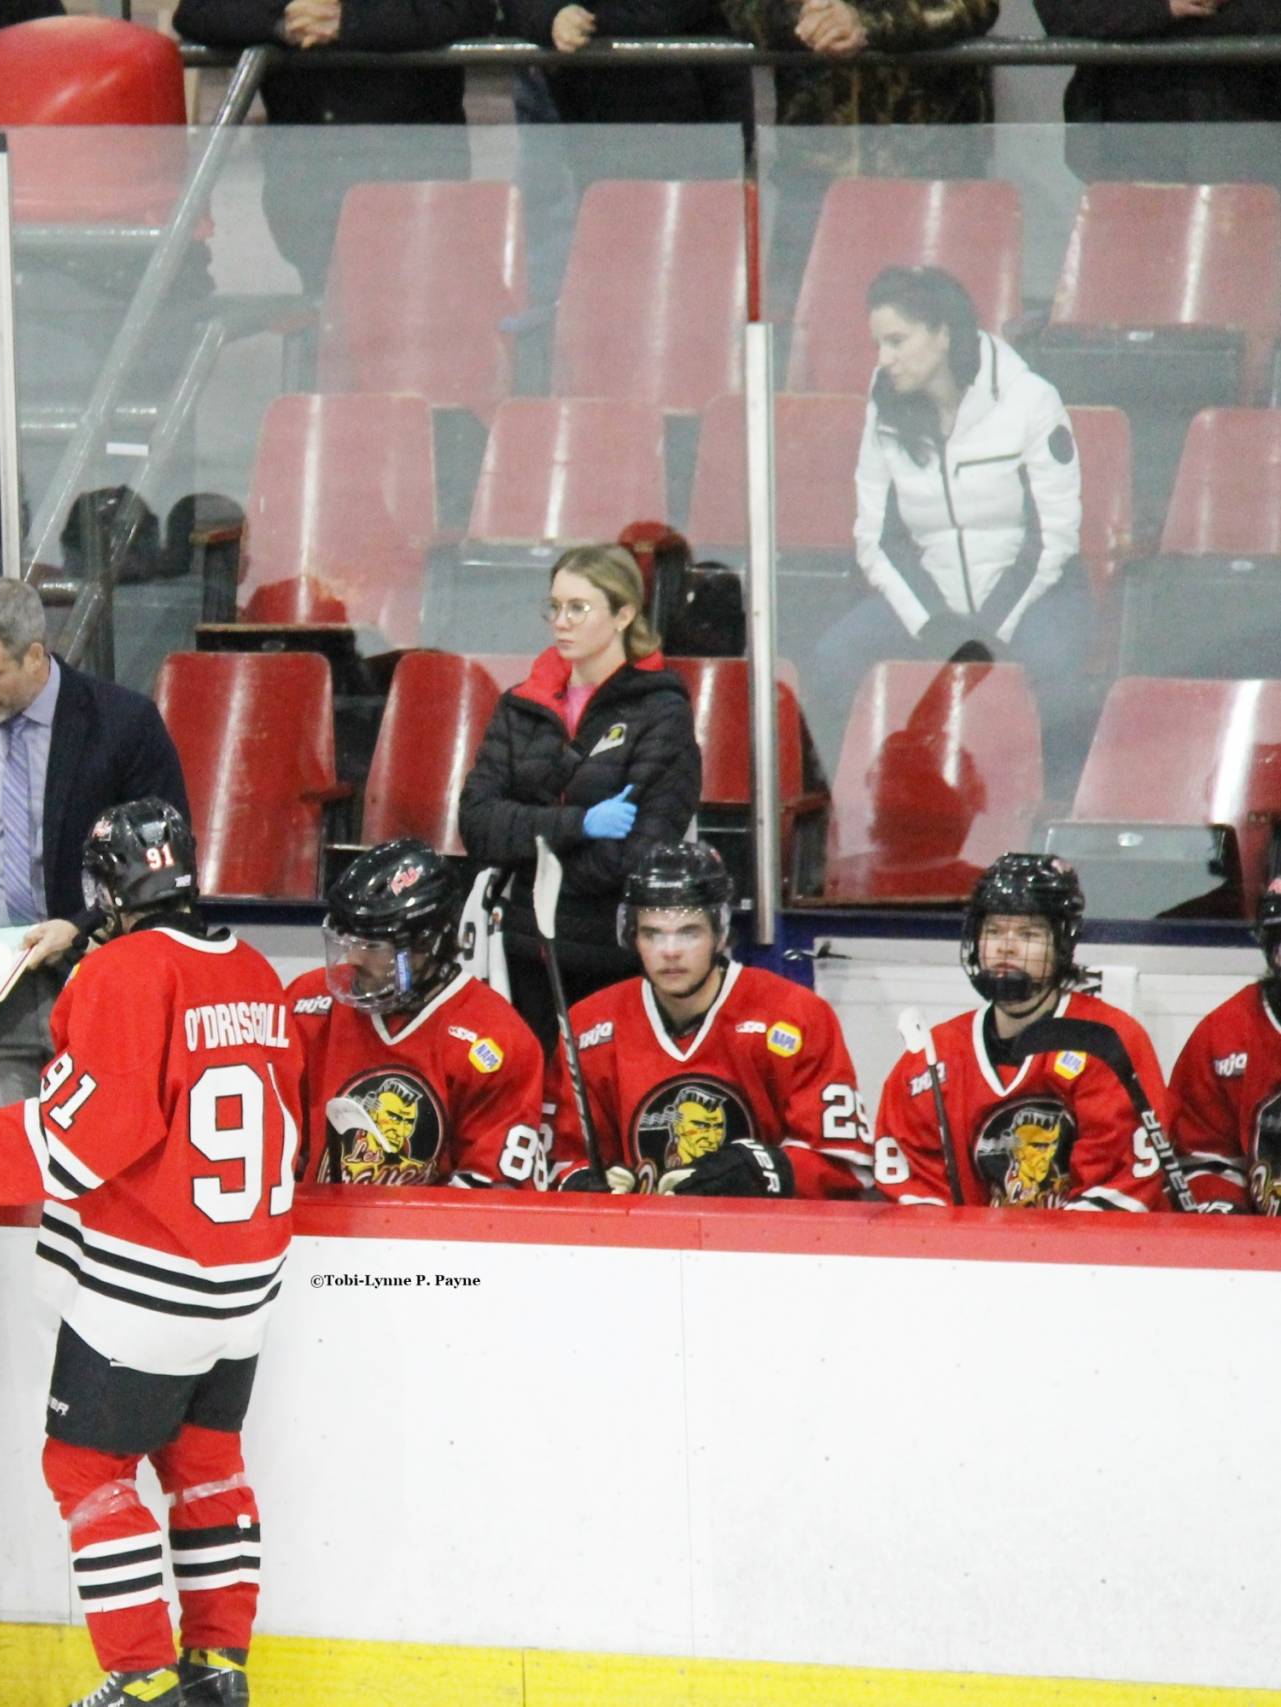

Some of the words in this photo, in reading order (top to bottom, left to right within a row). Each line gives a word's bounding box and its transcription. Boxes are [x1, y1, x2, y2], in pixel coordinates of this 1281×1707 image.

[146, 843, 175, 869] 91
[184, 1002, 290, 1052] O'DRISCOLL
[39, 1051, 98, 1130] 91
[189, 1064, 298, 1224] 91
